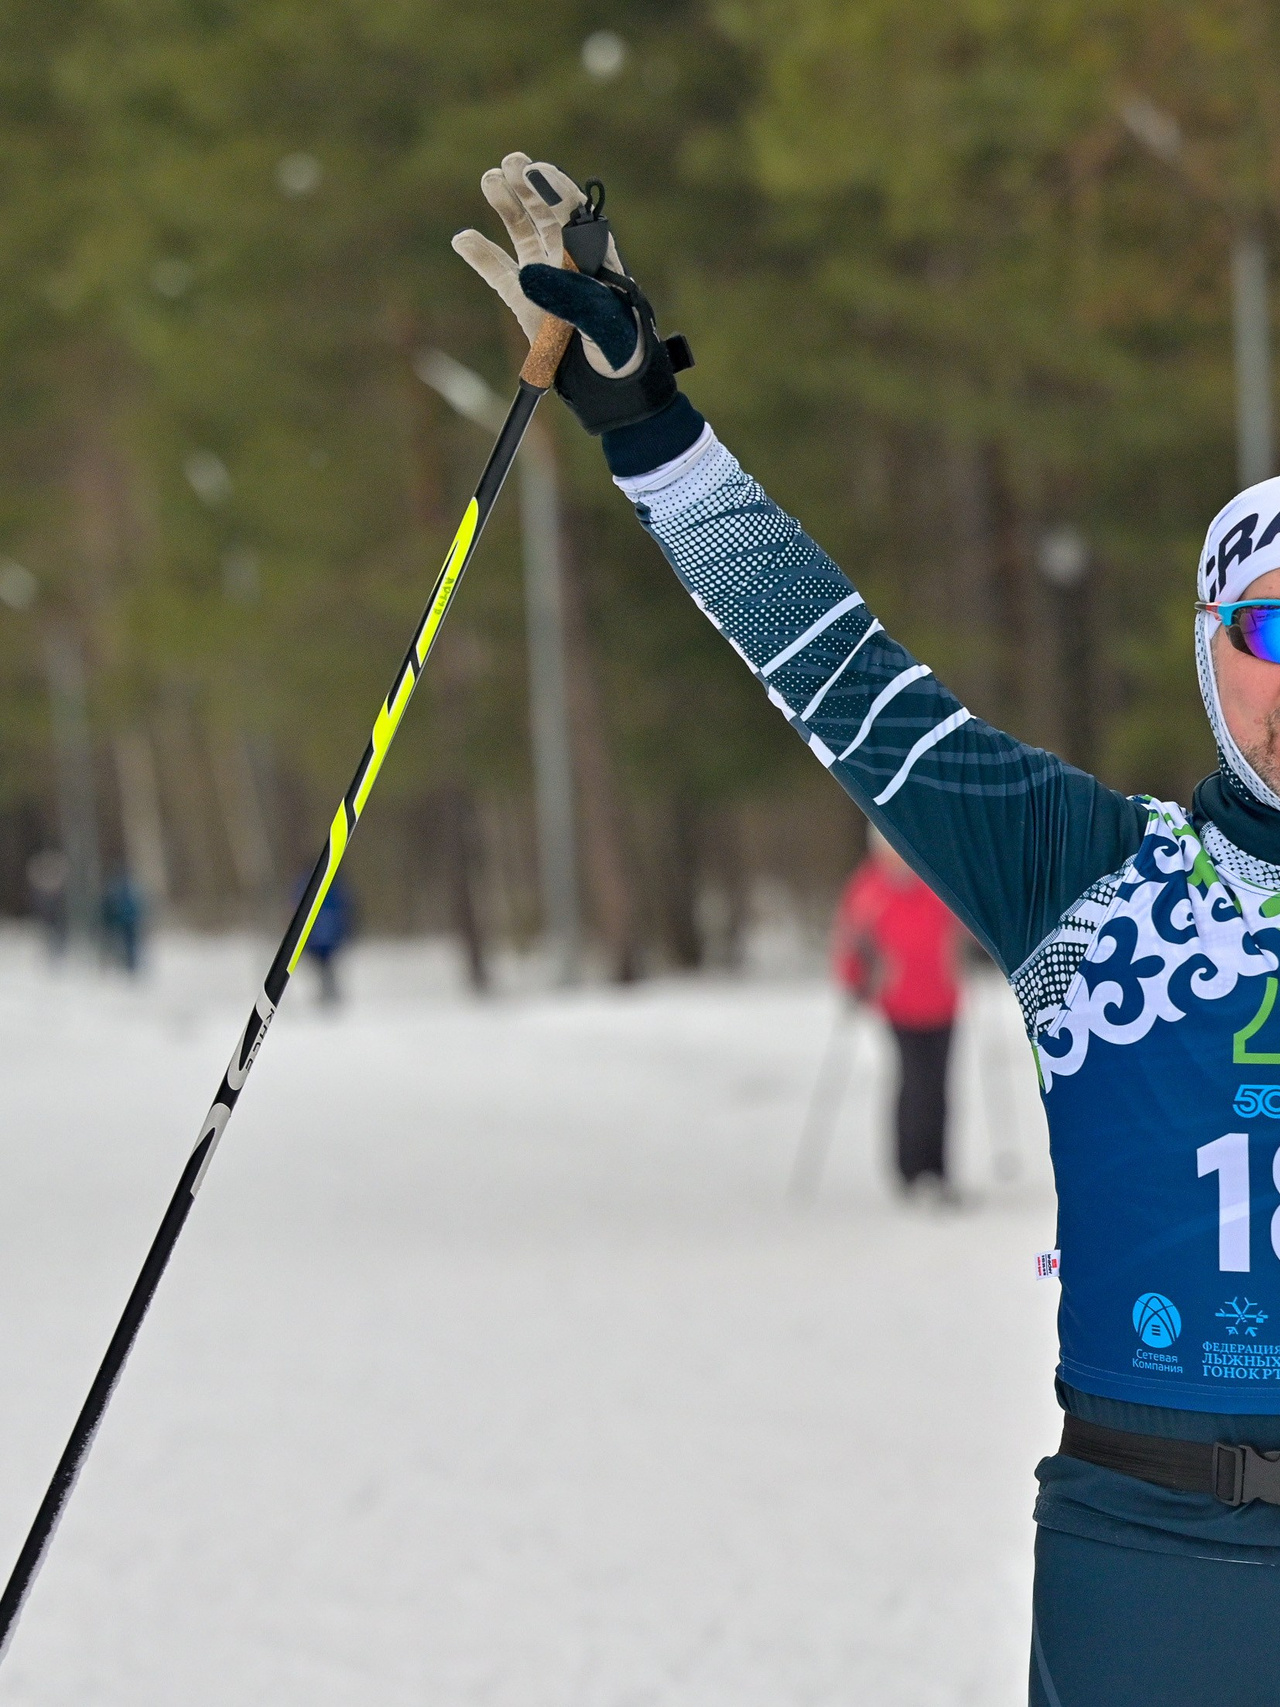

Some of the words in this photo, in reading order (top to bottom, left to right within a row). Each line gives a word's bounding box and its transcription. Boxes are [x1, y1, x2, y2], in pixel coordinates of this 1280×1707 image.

[1136, 1348, 1178, 1363] Сетевая
[1132, 1358, 1183, 1374] Компания
[1202, 1365, 1259, 1379] ГОНОК
